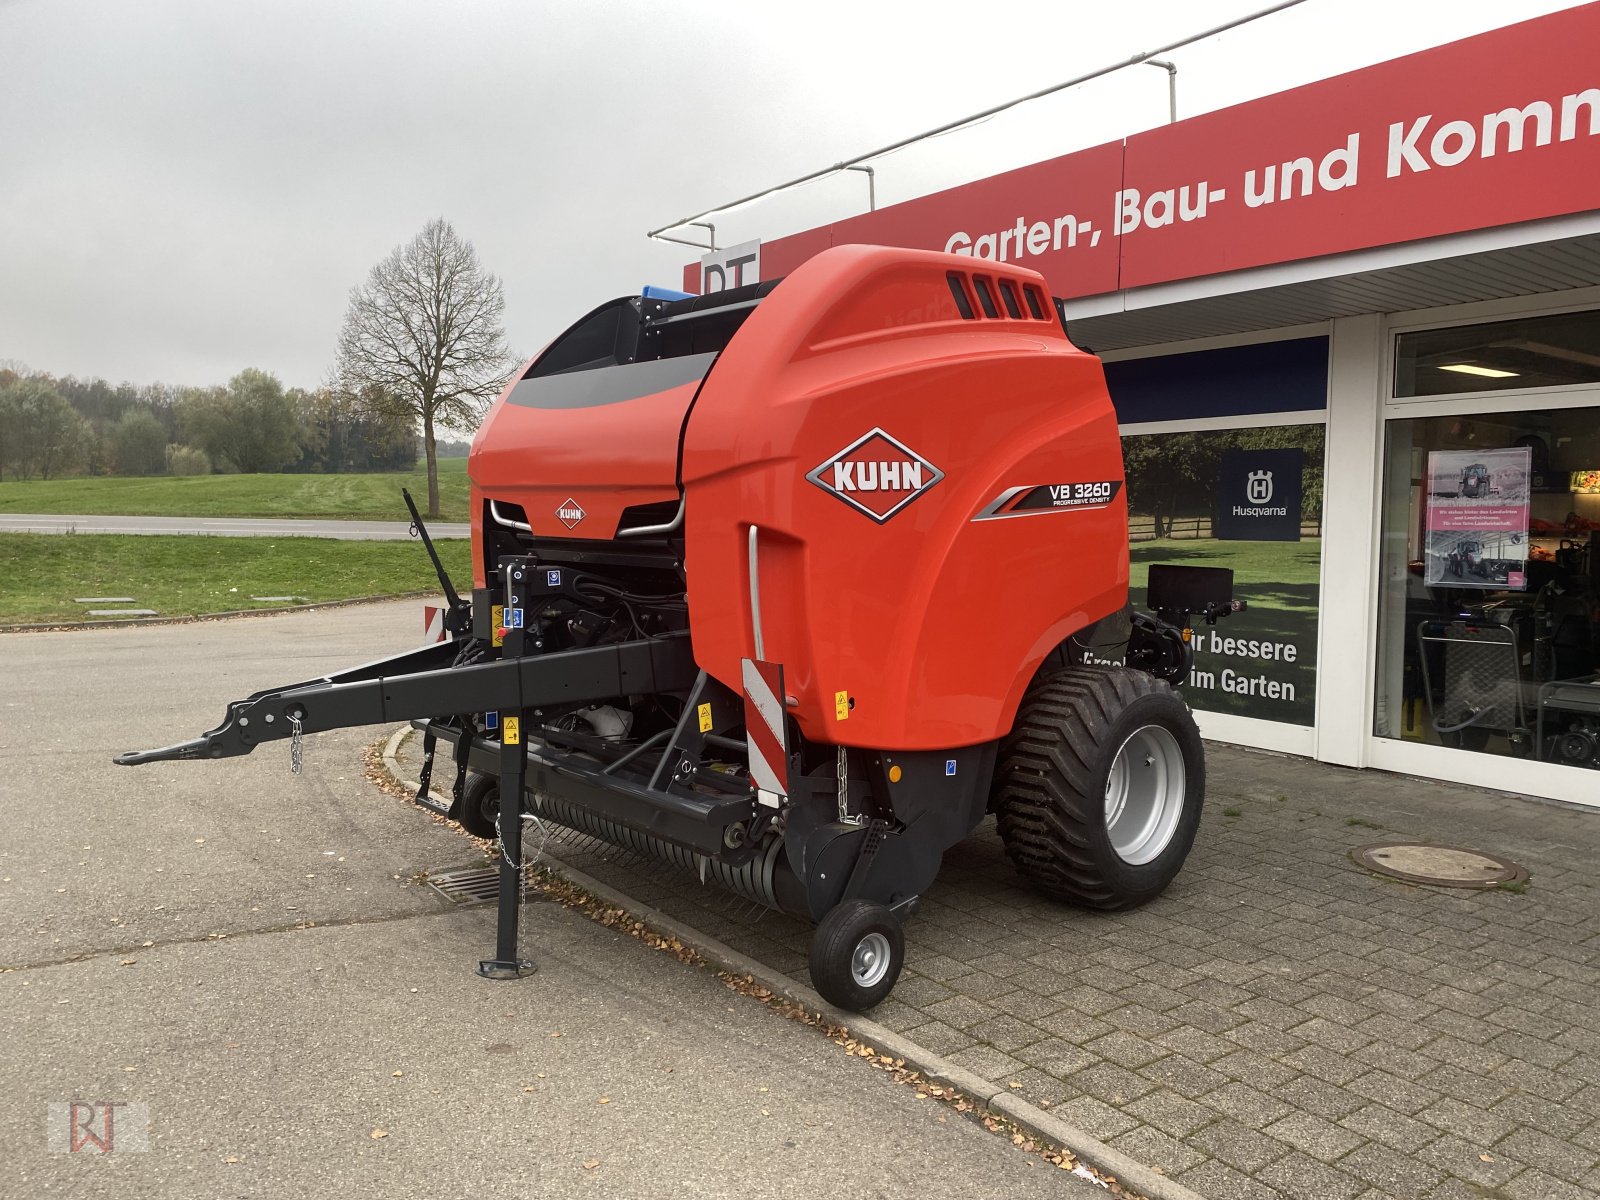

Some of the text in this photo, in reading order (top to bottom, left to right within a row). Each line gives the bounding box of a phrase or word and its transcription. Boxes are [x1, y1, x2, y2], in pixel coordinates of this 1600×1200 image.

[944, 214, 1102, 262] Garten-,
[1114, 181, 1226, 236] Bau-
[1244, 132, 1360, 208] und
[833, 461, 922, 491] KUHN
[1049, 482, 1110, 500] VB 3260
[559, 508, 582, 520] KUHN
[1232, 505, 1288, 518] Husqvarna
[1210, 630, 1298, 663] bessere
[1190, 665, 1296, 702] im Garten
